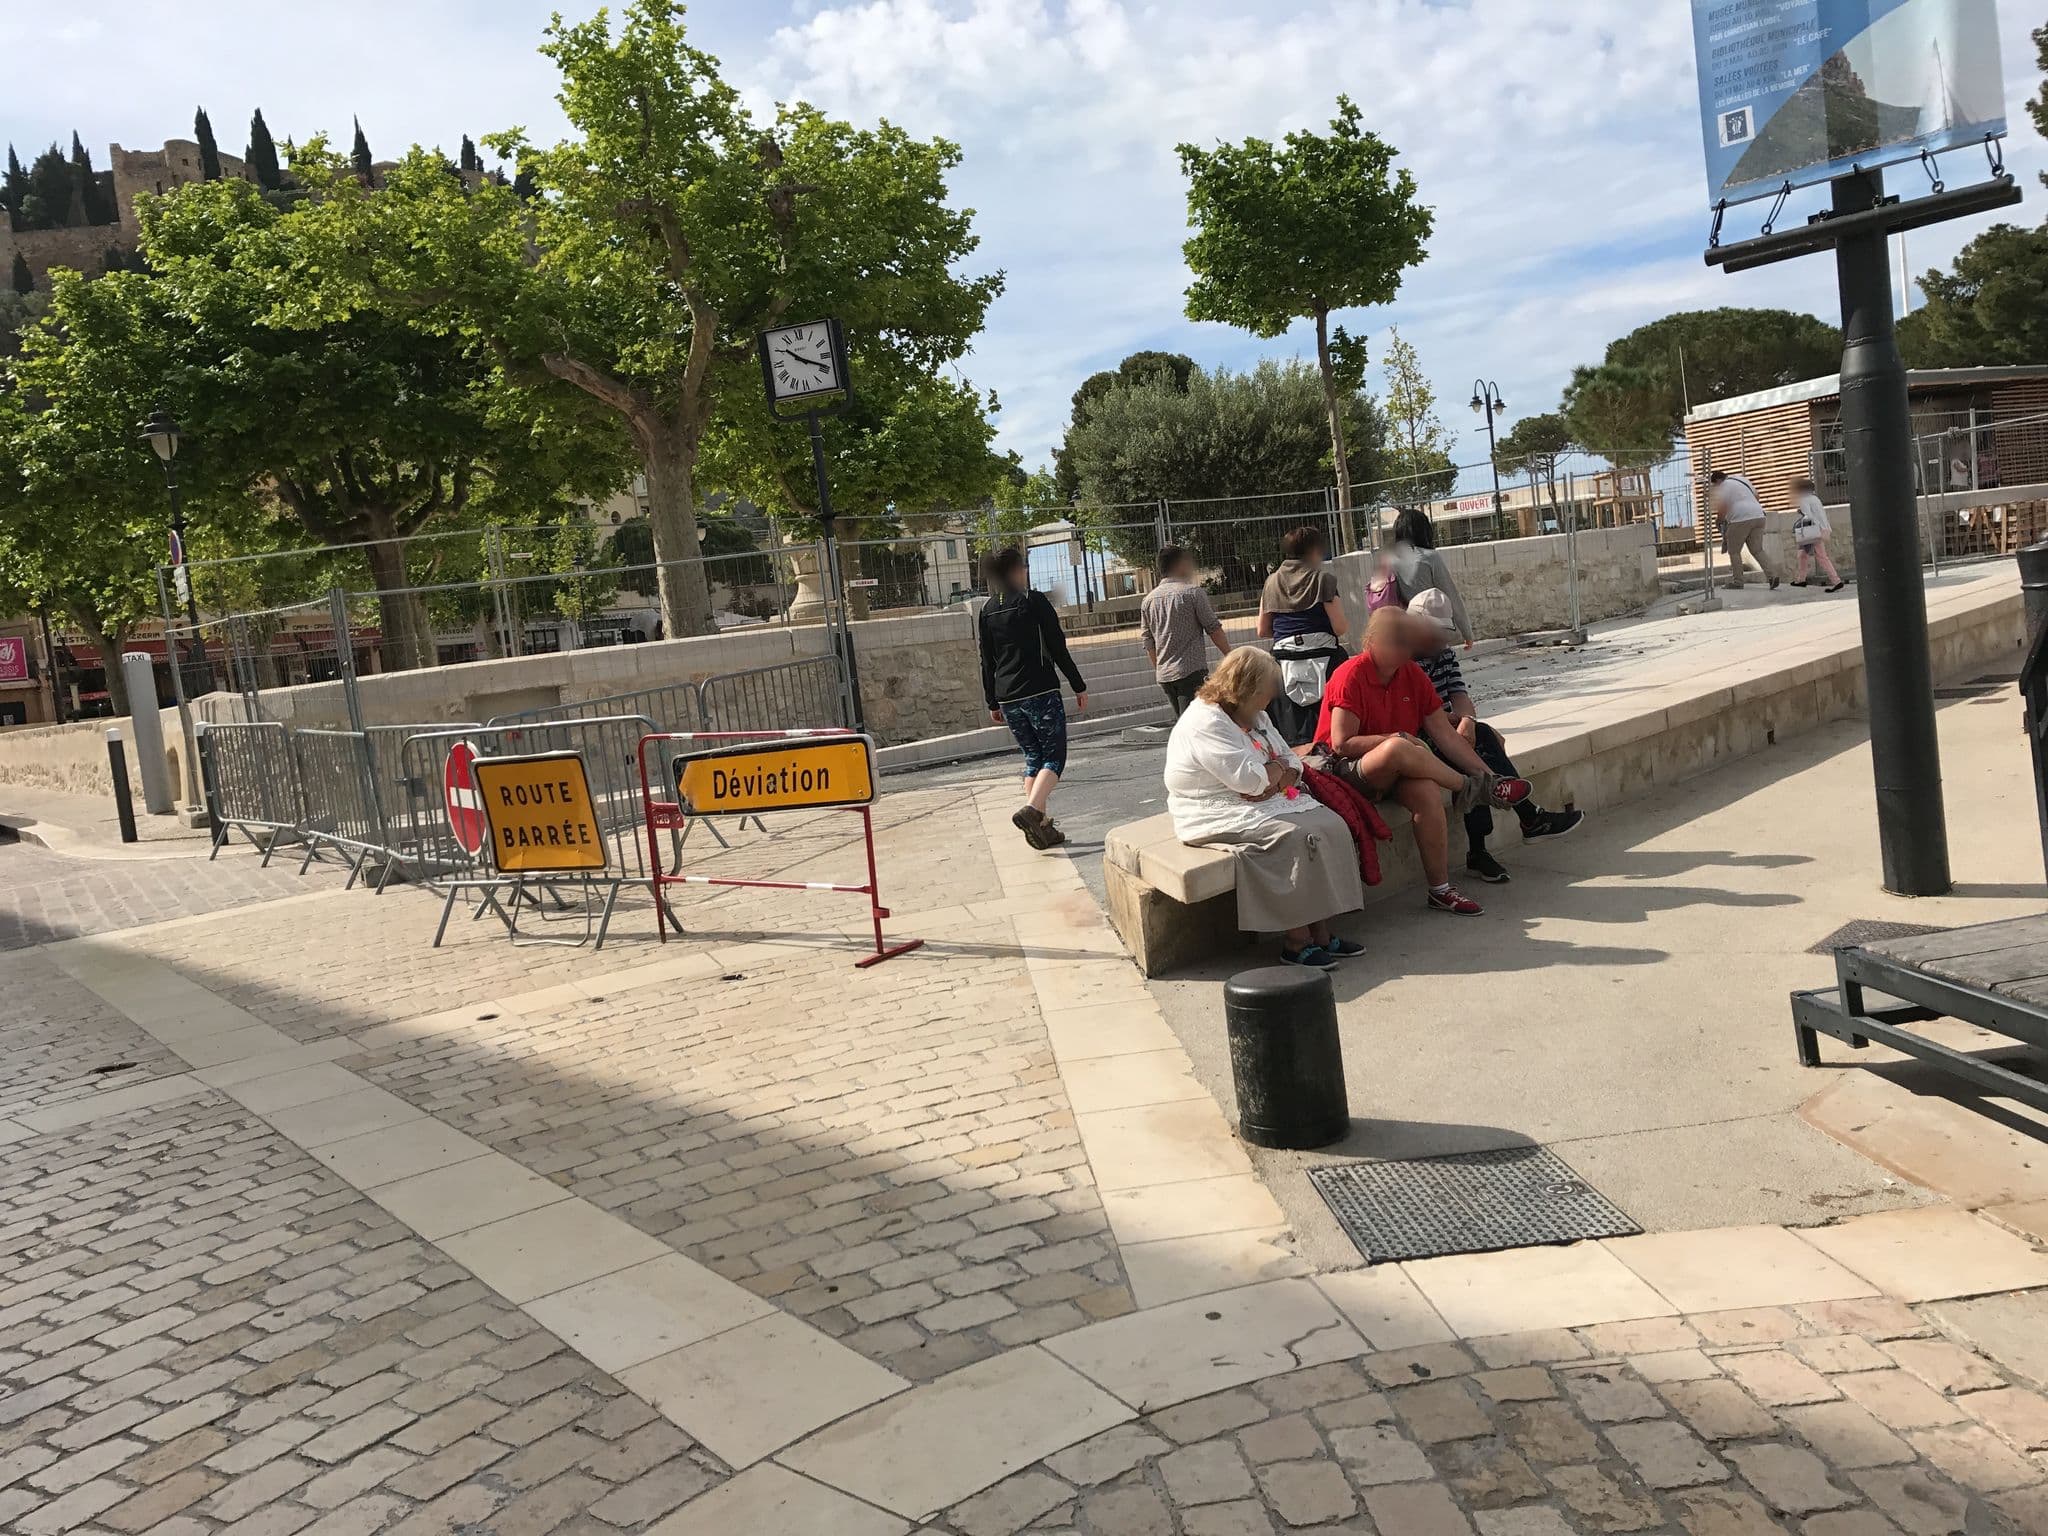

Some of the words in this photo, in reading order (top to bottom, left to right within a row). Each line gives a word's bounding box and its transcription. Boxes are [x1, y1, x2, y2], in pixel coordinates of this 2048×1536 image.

[1460, 497, 1489, 512] OUVERT
[126, 654, 145, 662] TAXI
[713, 762, 829, 799] Déviation
[500, 782, 573, 806] ROUTE
[502, 819, 591, 848] BARRÉE
